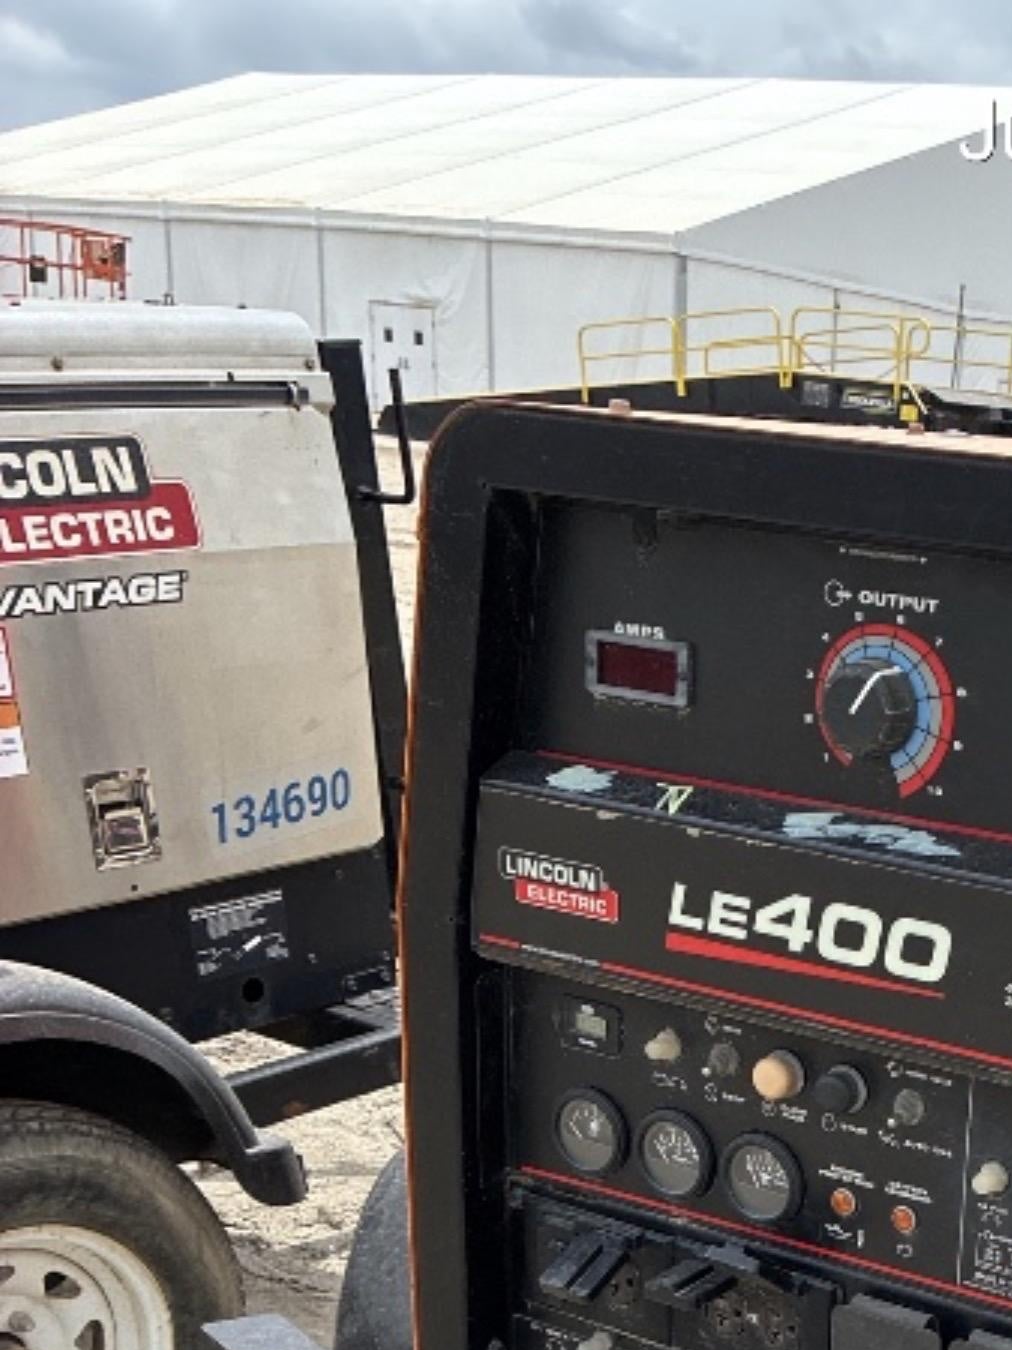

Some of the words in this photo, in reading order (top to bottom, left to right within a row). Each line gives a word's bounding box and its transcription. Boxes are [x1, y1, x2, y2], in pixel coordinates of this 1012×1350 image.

[857, 589, 940, 613] OUTPUT
[614, 621, 665, 641] AMPS
[212, 768, 351, 843] 134690
[506, 854, 597, 892] LINCOLN
[527, 883, 608, 915] ELECTRIC
[667, 881, 953, 983] LE400
